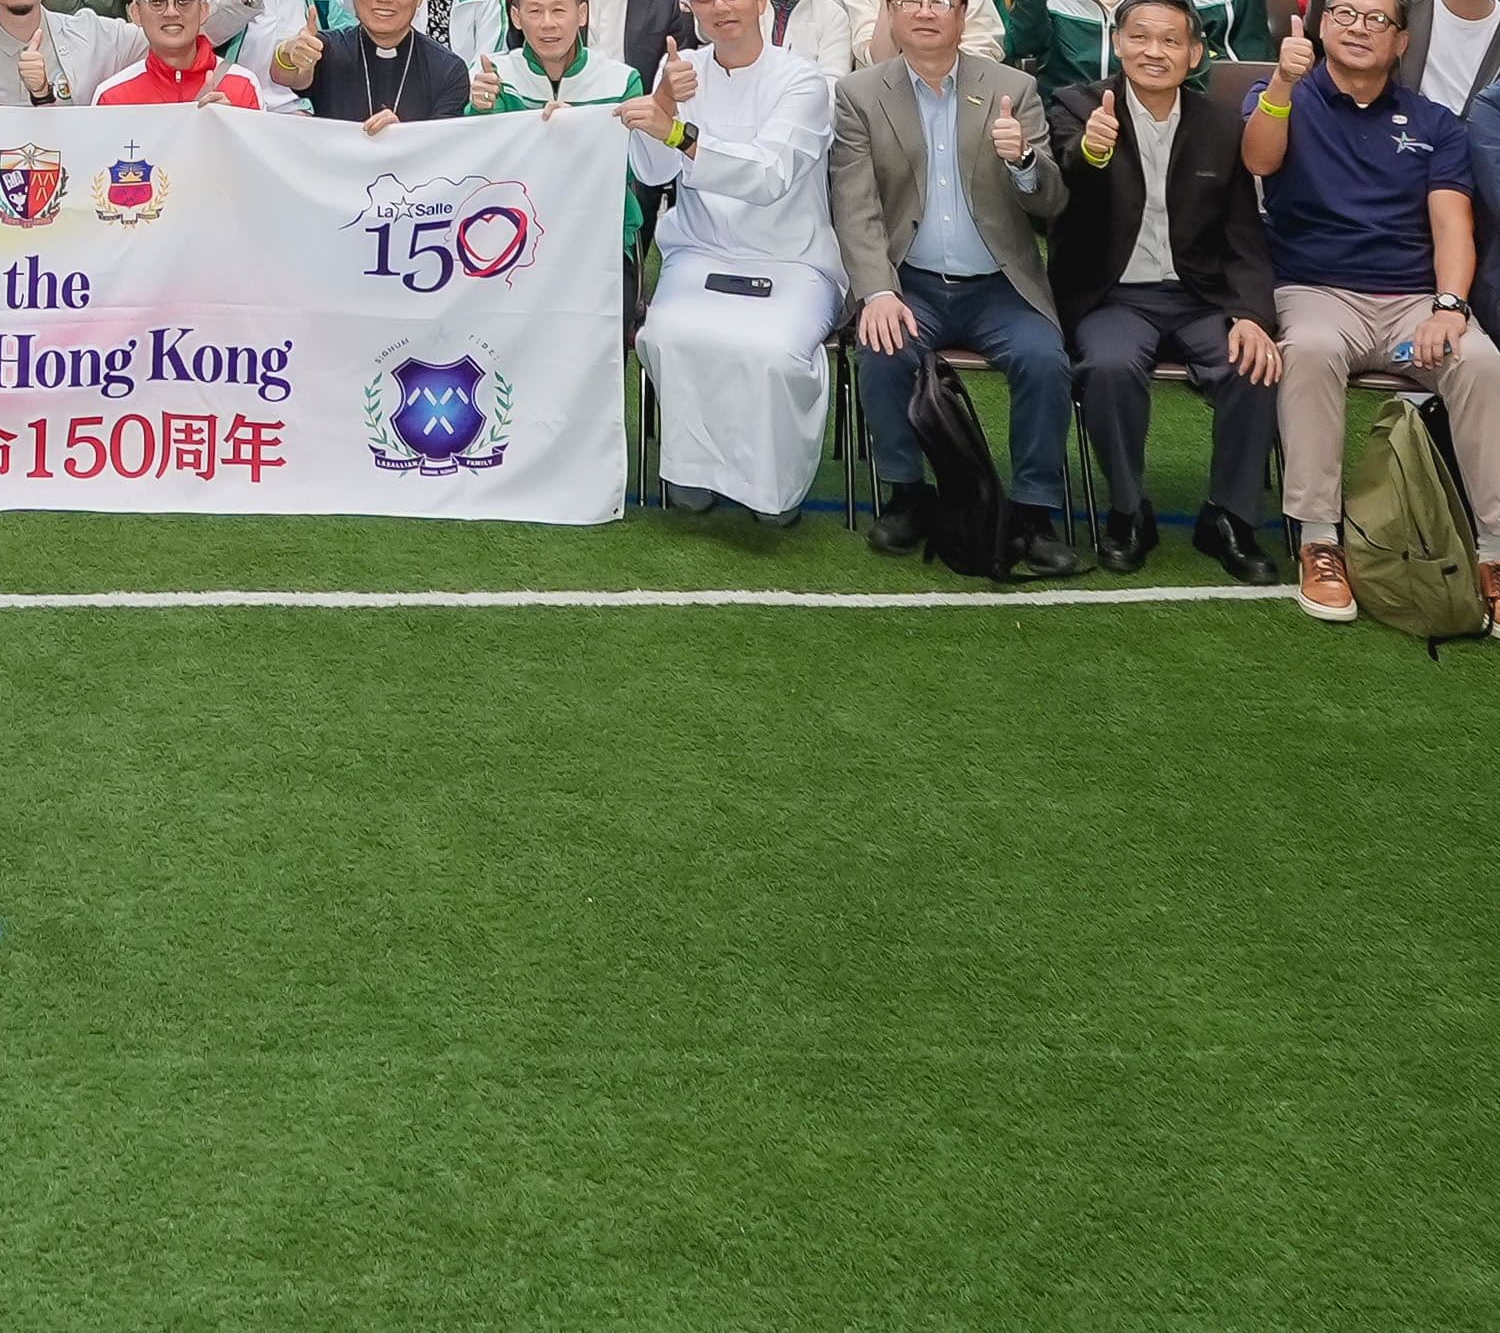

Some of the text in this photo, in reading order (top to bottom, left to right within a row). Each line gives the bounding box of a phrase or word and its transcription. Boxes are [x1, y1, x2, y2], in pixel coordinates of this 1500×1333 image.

[376, 203, 453, 219] La Salle
[363, 206, 528, 293] 150
[3, 255, 91, 310] the
[146, 327, 293, 403] Kong
